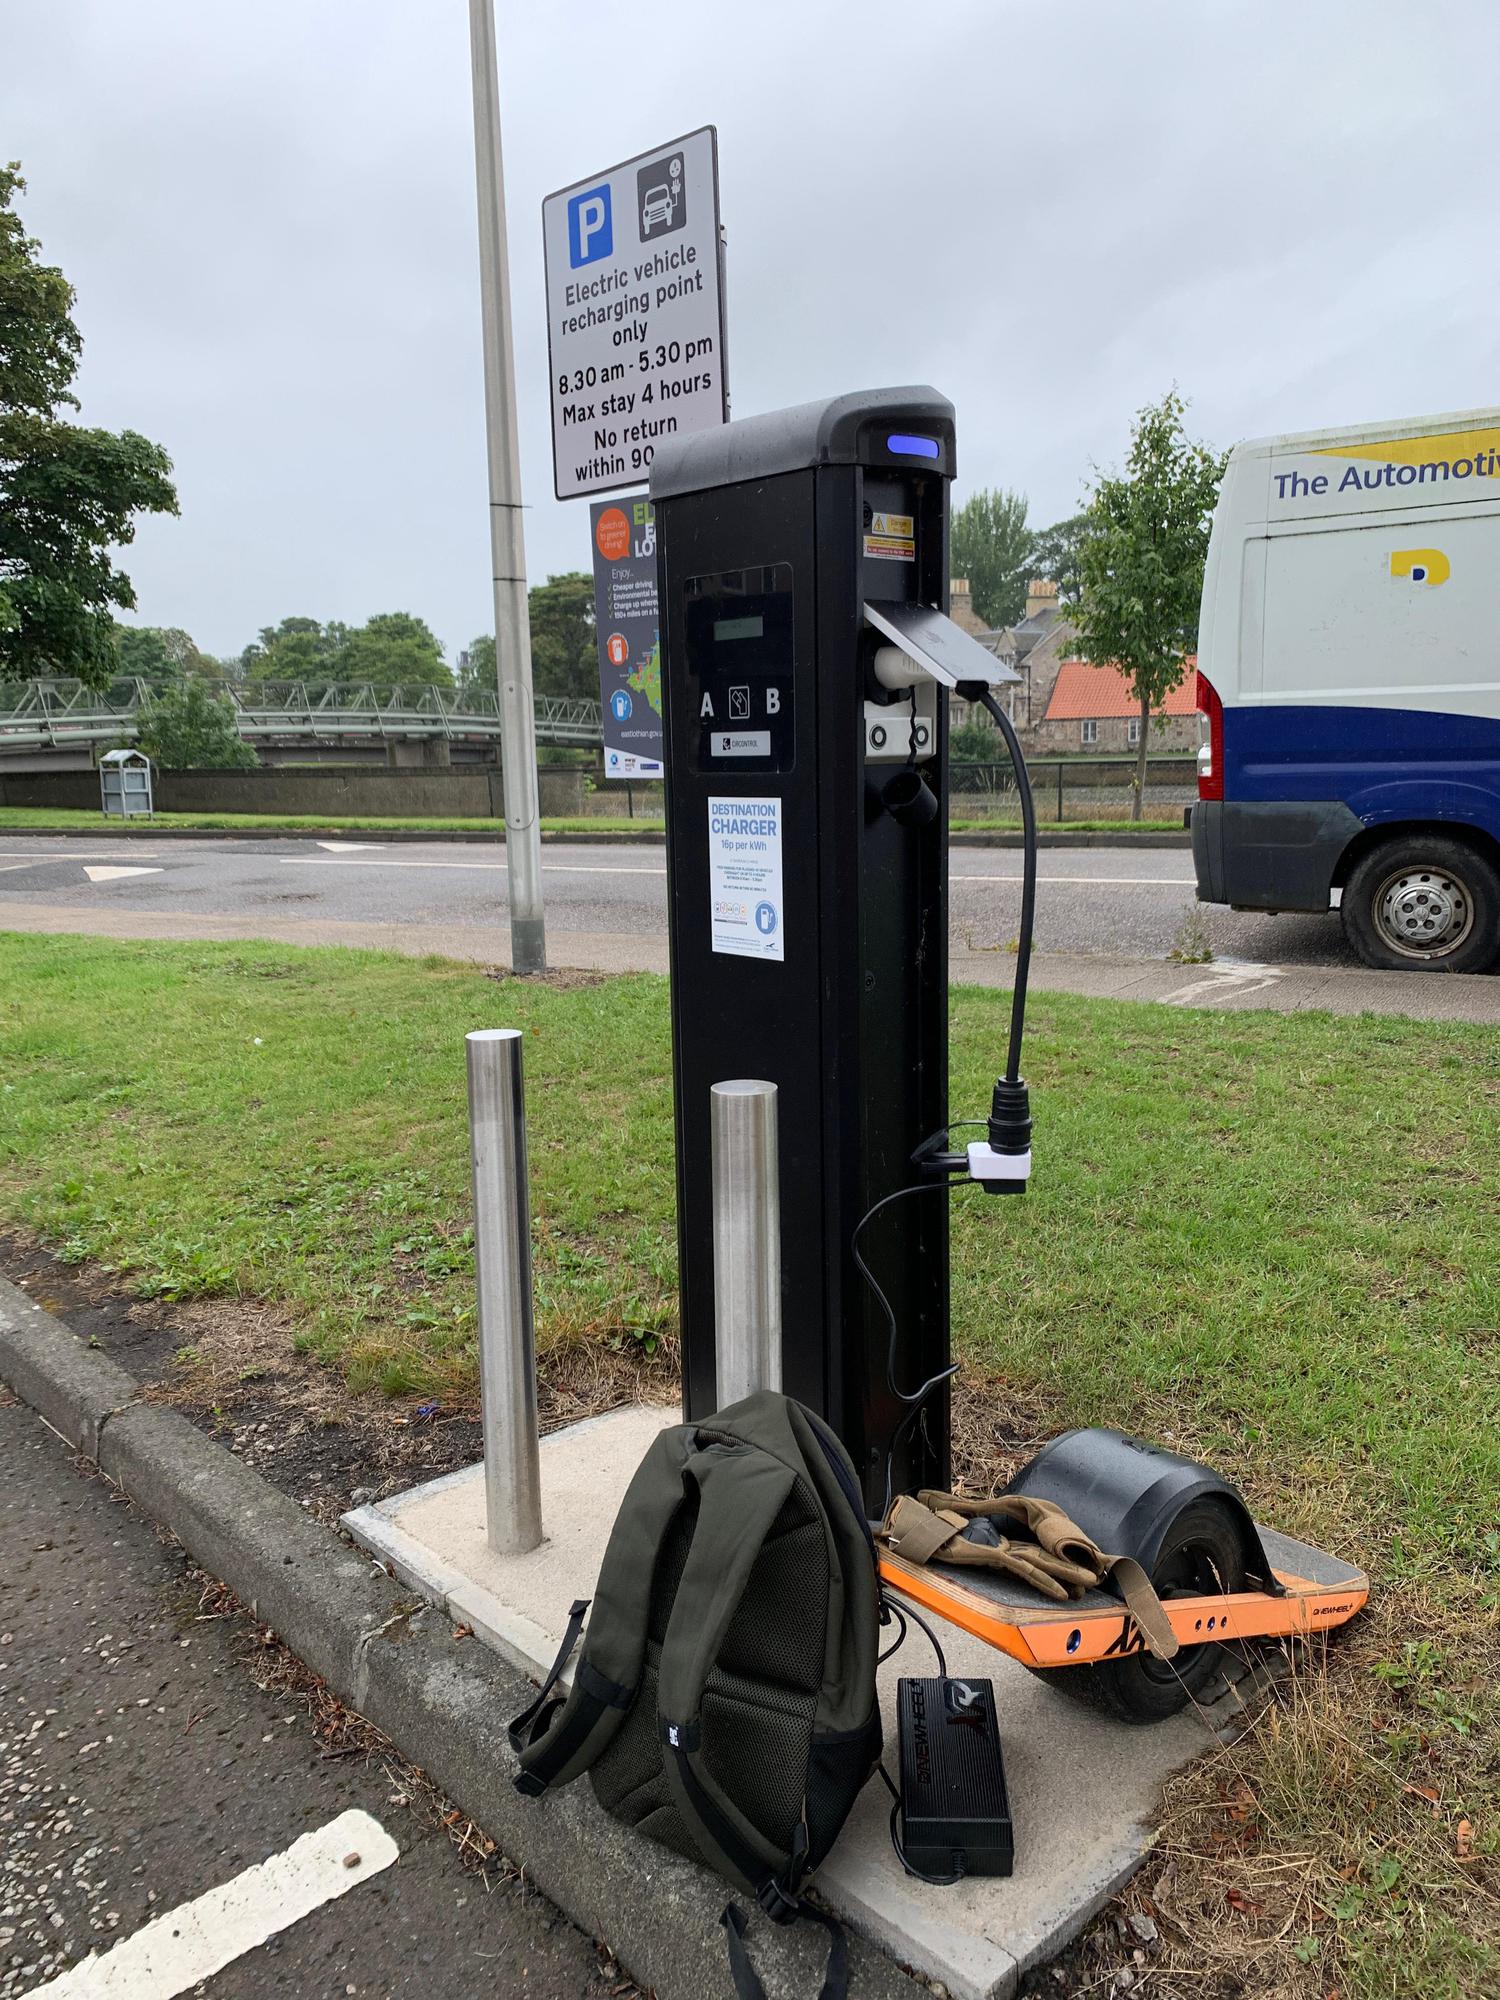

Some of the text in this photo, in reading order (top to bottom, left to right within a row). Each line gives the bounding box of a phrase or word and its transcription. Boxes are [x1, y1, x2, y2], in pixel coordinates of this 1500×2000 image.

[565, 243, 697, 307] Electric vehicle
[561, 269, 703, 336] recharging point
[612, 320, 649, 348] only
[558, 366, 597, 396] 8.30
[601, 361, 625, 383] am
[638, 341, 681, 373] 5.30
[685, 335, 713, 364] pm
[562, 370, 711, 427] Max stay 4 hours
[594, 415, 678, 451] No return
[575, 444, 654, 482] within 90
[1274, 471, 1329, 499] The
[613, 580, 653, 592] Cheaper driving
[613, 590, 650, 601] Environmental
[614, 600, 633, 611] Charge
[633, 601, 641, 610] up
[627, 609, 641, 618] miles
[700, 688, 780, 717] A B
[711, 803, 776, 817] DESTINATION
[711, 818, 777, 836] CHARGER
[721, 839, 767, 852] 16p per kWh
